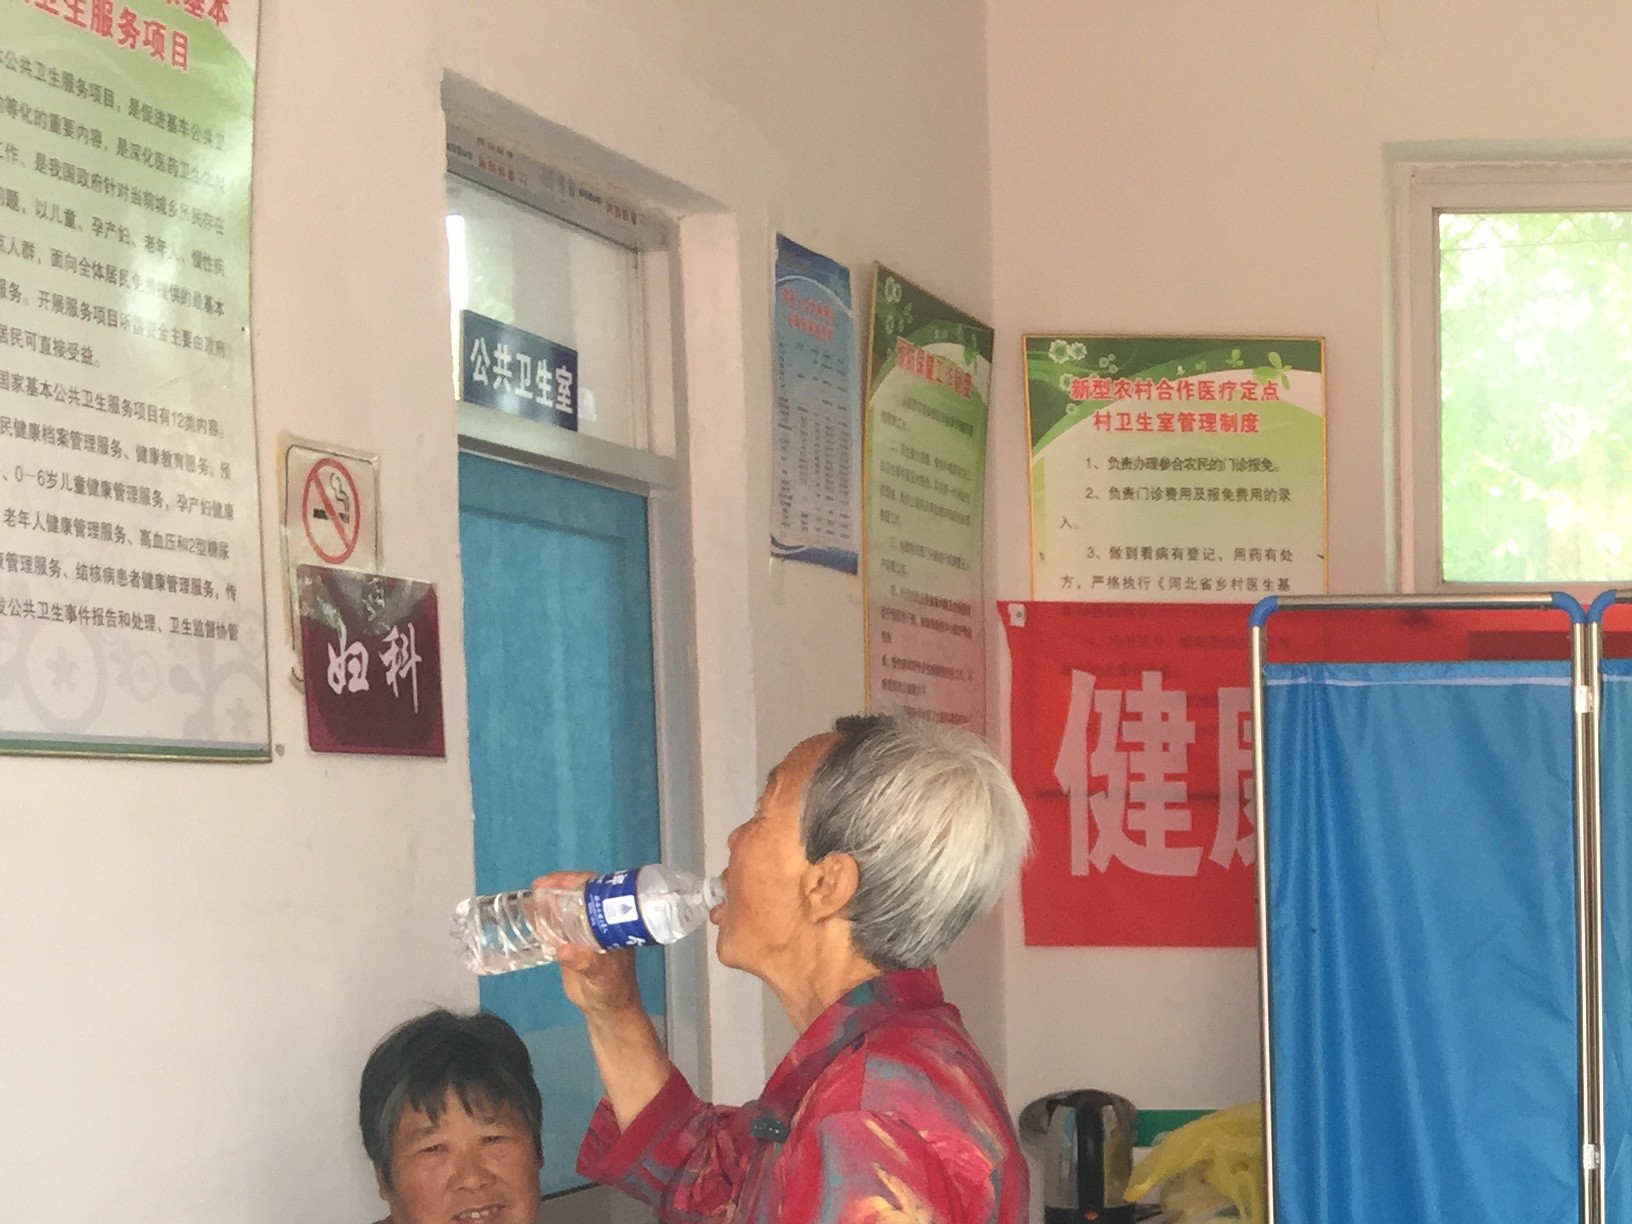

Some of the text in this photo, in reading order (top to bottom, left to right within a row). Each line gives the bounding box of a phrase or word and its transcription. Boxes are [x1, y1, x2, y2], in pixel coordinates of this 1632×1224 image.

[166, 0, 229, 26] 基本
[469, 336, 575, 415] 公共卫生室
[1071, 378, 1280, 402] 新型农村合作医疗定点
[1093, 411, 1259, 433] 村卫生室管理制度
[326, 621, 423, 715] 妇科
